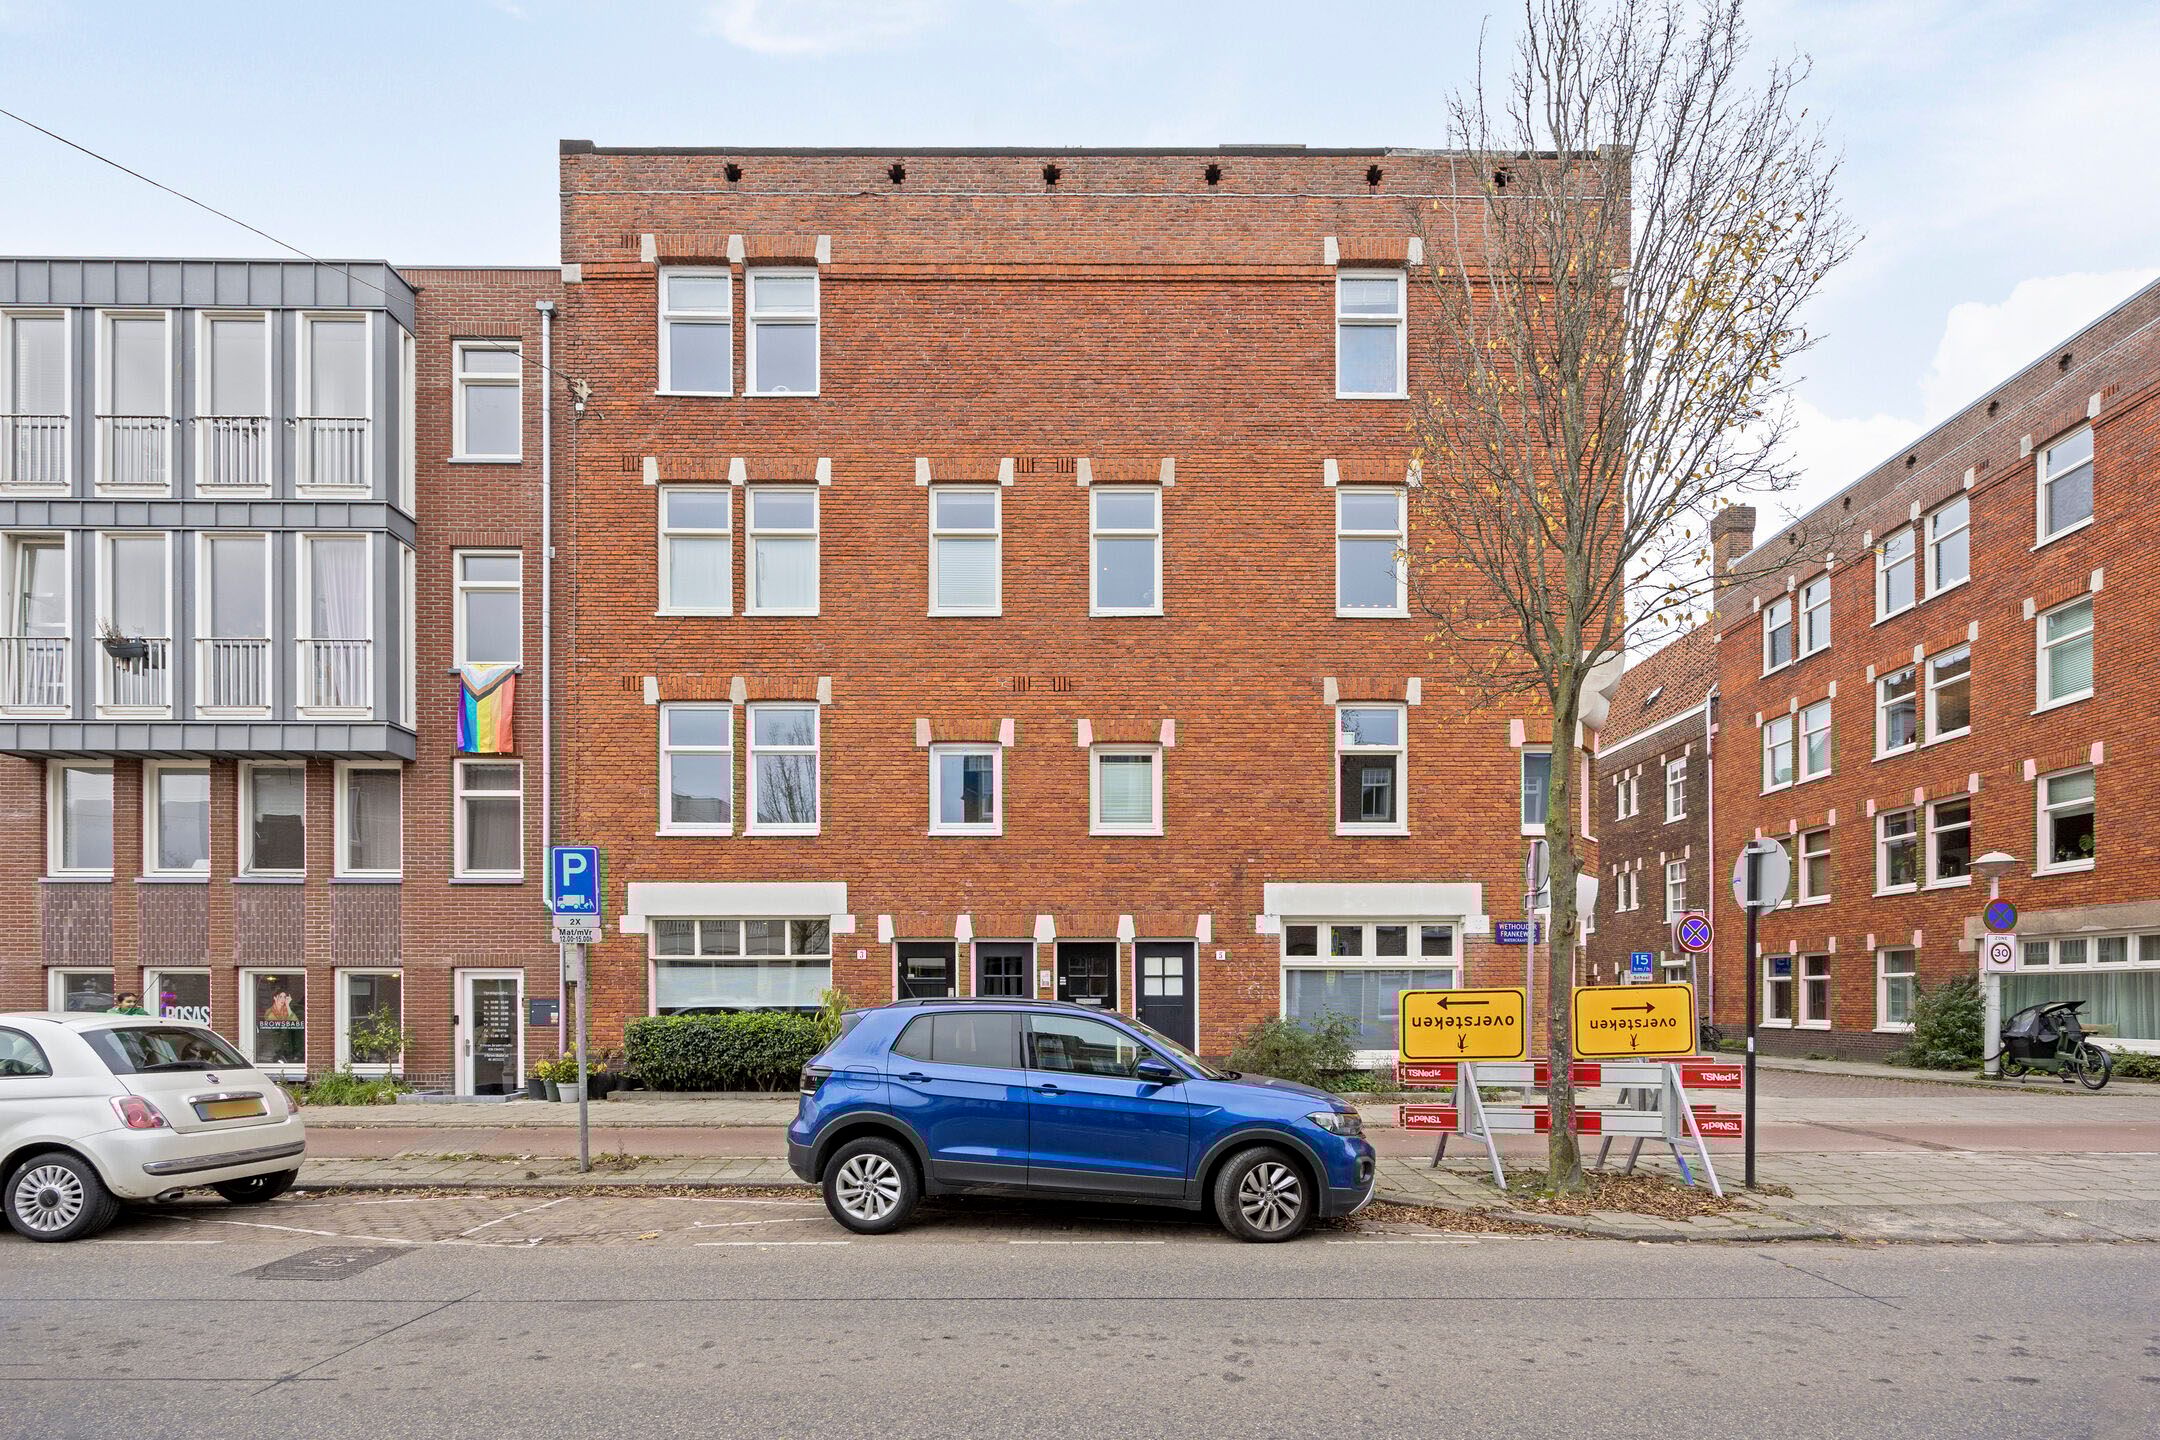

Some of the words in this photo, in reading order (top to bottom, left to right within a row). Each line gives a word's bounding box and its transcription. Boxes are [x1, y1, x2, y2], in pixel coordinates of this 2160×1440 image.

[562, 853, 587, 886] P
[569, 918, 581, 926] 2X
[1994, 948, 2009, 958] 30
[1635, 954, 1649, 965] 15
[1411, 1015, 1515, 1030] oversteken
[1589, 1017, 1677, 1031] oversteken
[1407, 1069, 1435, 1078] TSNed
[1700, 1072, 1732, 1081] TSNed
[1414, 1115, 1441, 1124] TSNed
[1707, 1120, 1740, 1131] TSNed
